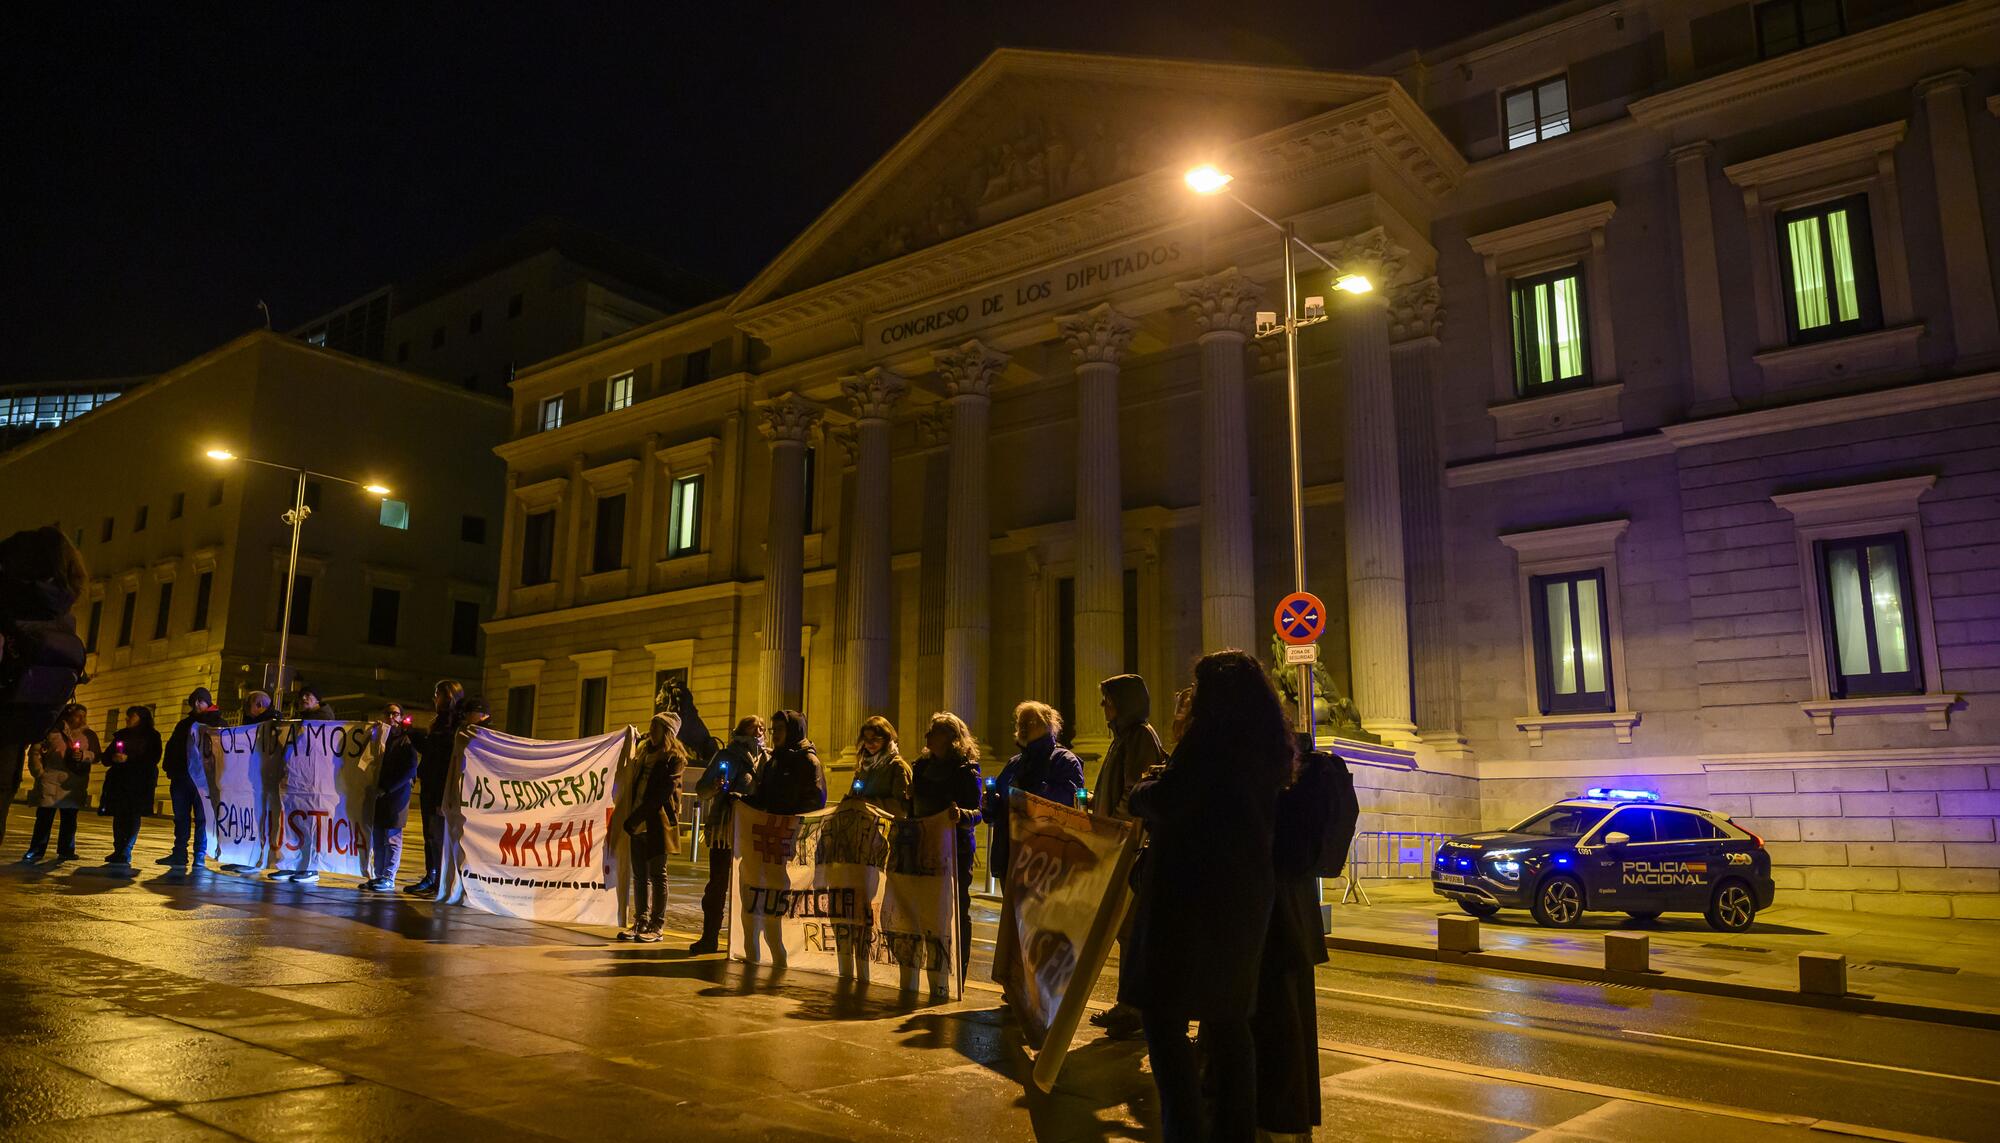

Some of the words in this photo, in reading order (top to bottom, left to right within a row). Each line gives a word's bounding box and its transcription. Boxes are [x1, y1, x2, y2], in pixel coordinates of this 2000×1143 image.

[881, 305, 969, 345] CONGRESO
[981, 294, 1004, 317] DE
[1016, 281, 1051, 307] LOS
[1066, 241, 1181, 292] DIPUTADOS
[219, 722, 365, 758] OLVIDAMOS
[459, 773, 495, 810] LAS
[499, 767, 609, 811] FRONTERAS
[1622, 861, 1690, 873] POLICIA
[1622, 873, 1708, 885] NACIONAL
[747, 886, 857, 919] JUSTICIA
